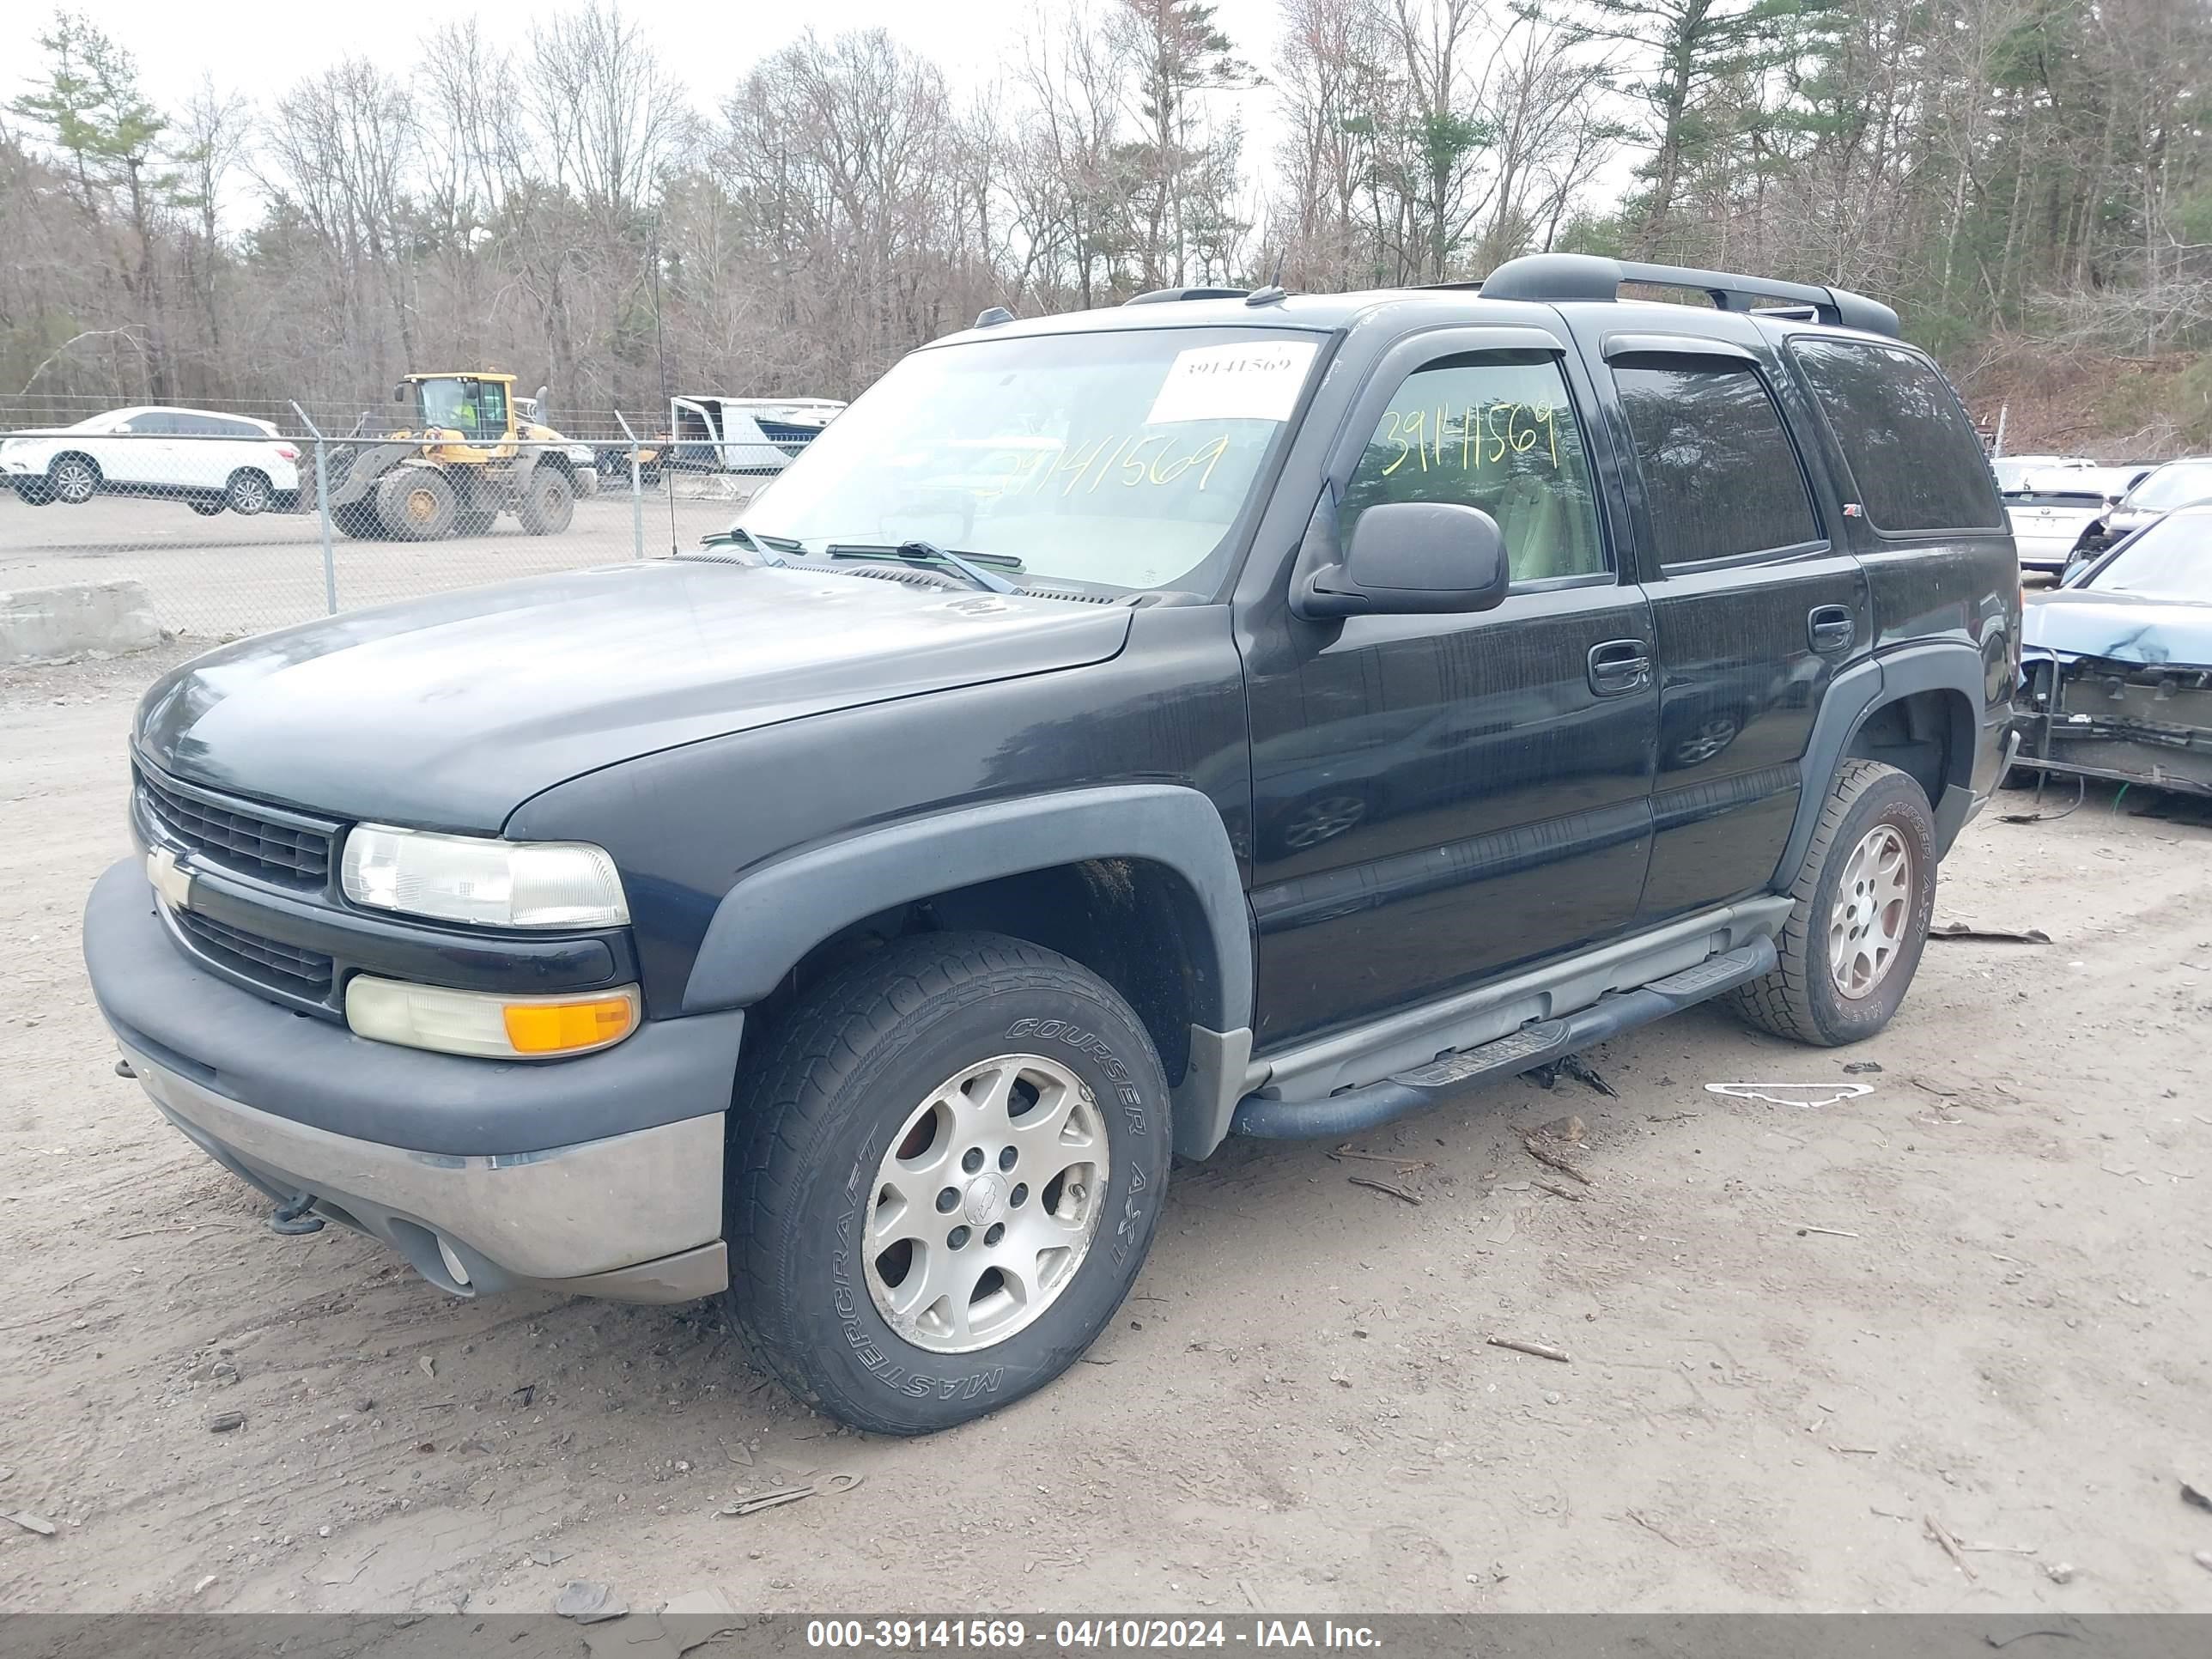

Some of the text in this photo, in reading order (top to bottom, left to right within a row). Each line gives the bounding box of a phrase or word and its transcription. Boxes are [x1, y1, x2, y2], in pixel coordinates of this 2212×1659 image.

[969, 433, 1230, 497] 39141569
[1382, 398, 1559, 475] 39141569
[1004, 1018, 1149, 1266] COURSER AXT
[831, 1121, 1005, 1401] MASTERCRAFT
